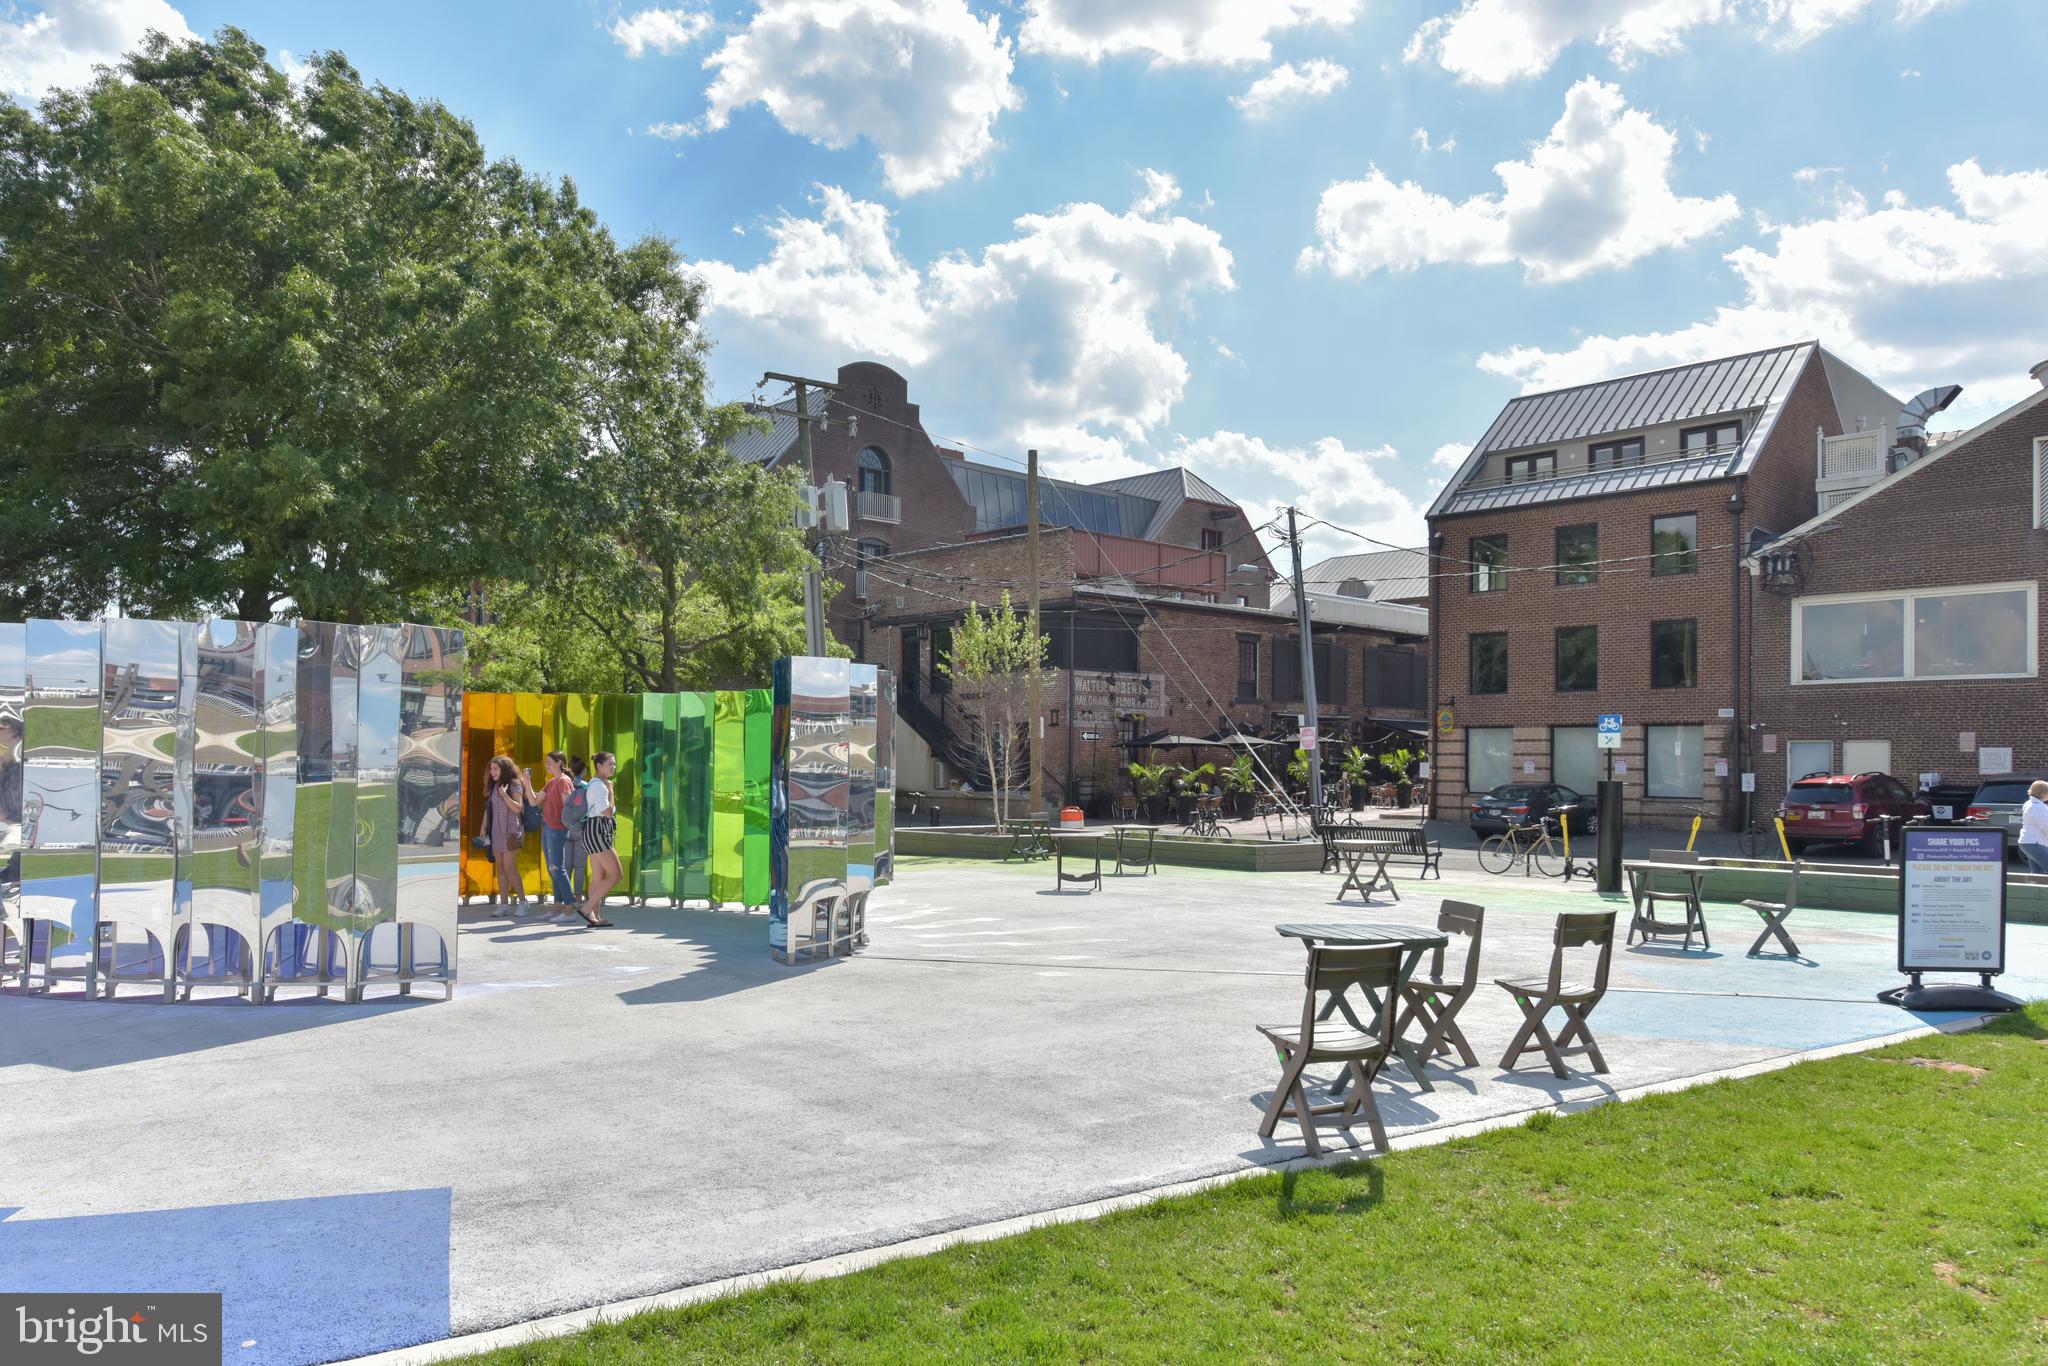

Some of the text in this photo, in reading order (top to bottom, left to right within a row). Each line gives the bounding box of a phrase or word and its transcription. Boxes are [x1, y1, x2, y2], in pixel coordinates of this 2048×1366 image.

[1074, 677, 1107, 693] WALTER
[1928, 838, 1980, 846] SHARE YOUR PICS
